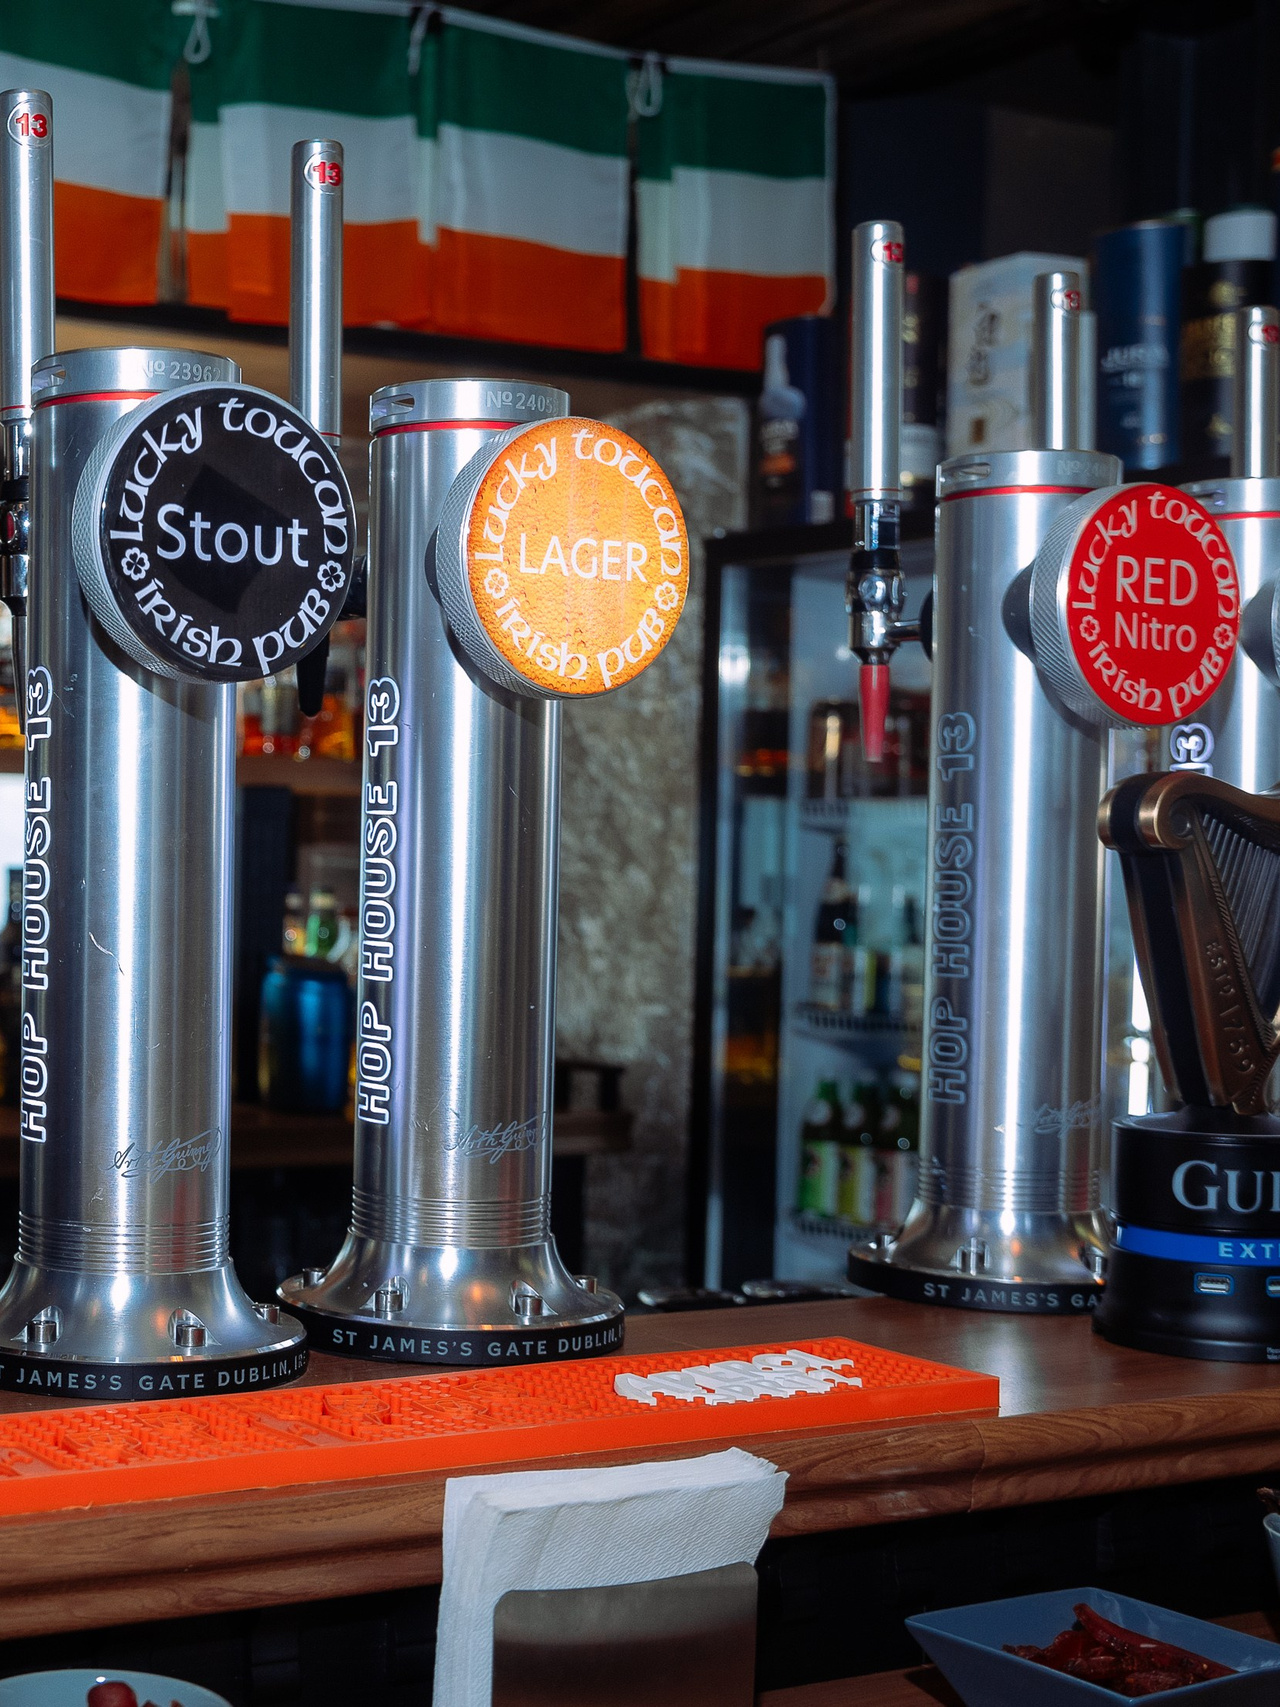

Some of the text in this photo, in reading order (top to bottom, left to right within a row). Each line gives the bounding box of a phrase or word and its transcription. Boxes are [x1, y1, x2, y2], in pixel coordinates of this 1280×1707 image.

[15, 112, 48, 139] 13
[313, 161, 342, 187] 13
[156, 503, 309, 567] Stout
[520, 533, 648, 583] LAGER
[1116, 555, 1199, 606] RED
[1114, 611, 1197, 652] Nitro
[21, 665, 53, 1143] HOP HOUSE 13
[358, 676, 401, 1125] HOP HOUSE 13
[928, 711, 977, 1104] HOP HOUSE 13
[923, 1282, 950, 1298] ST
[961, 1288, 1059, 1308] JAMES'S
[332, 1328, 357, 1346] ST
[370, 1334, 473, 1357] JAMES'S
[487, 1340, 548, 1357] GATE
[16, 1367, 122, 1391] JAMES'S
[138, 1373, 205, 1391] GATE
